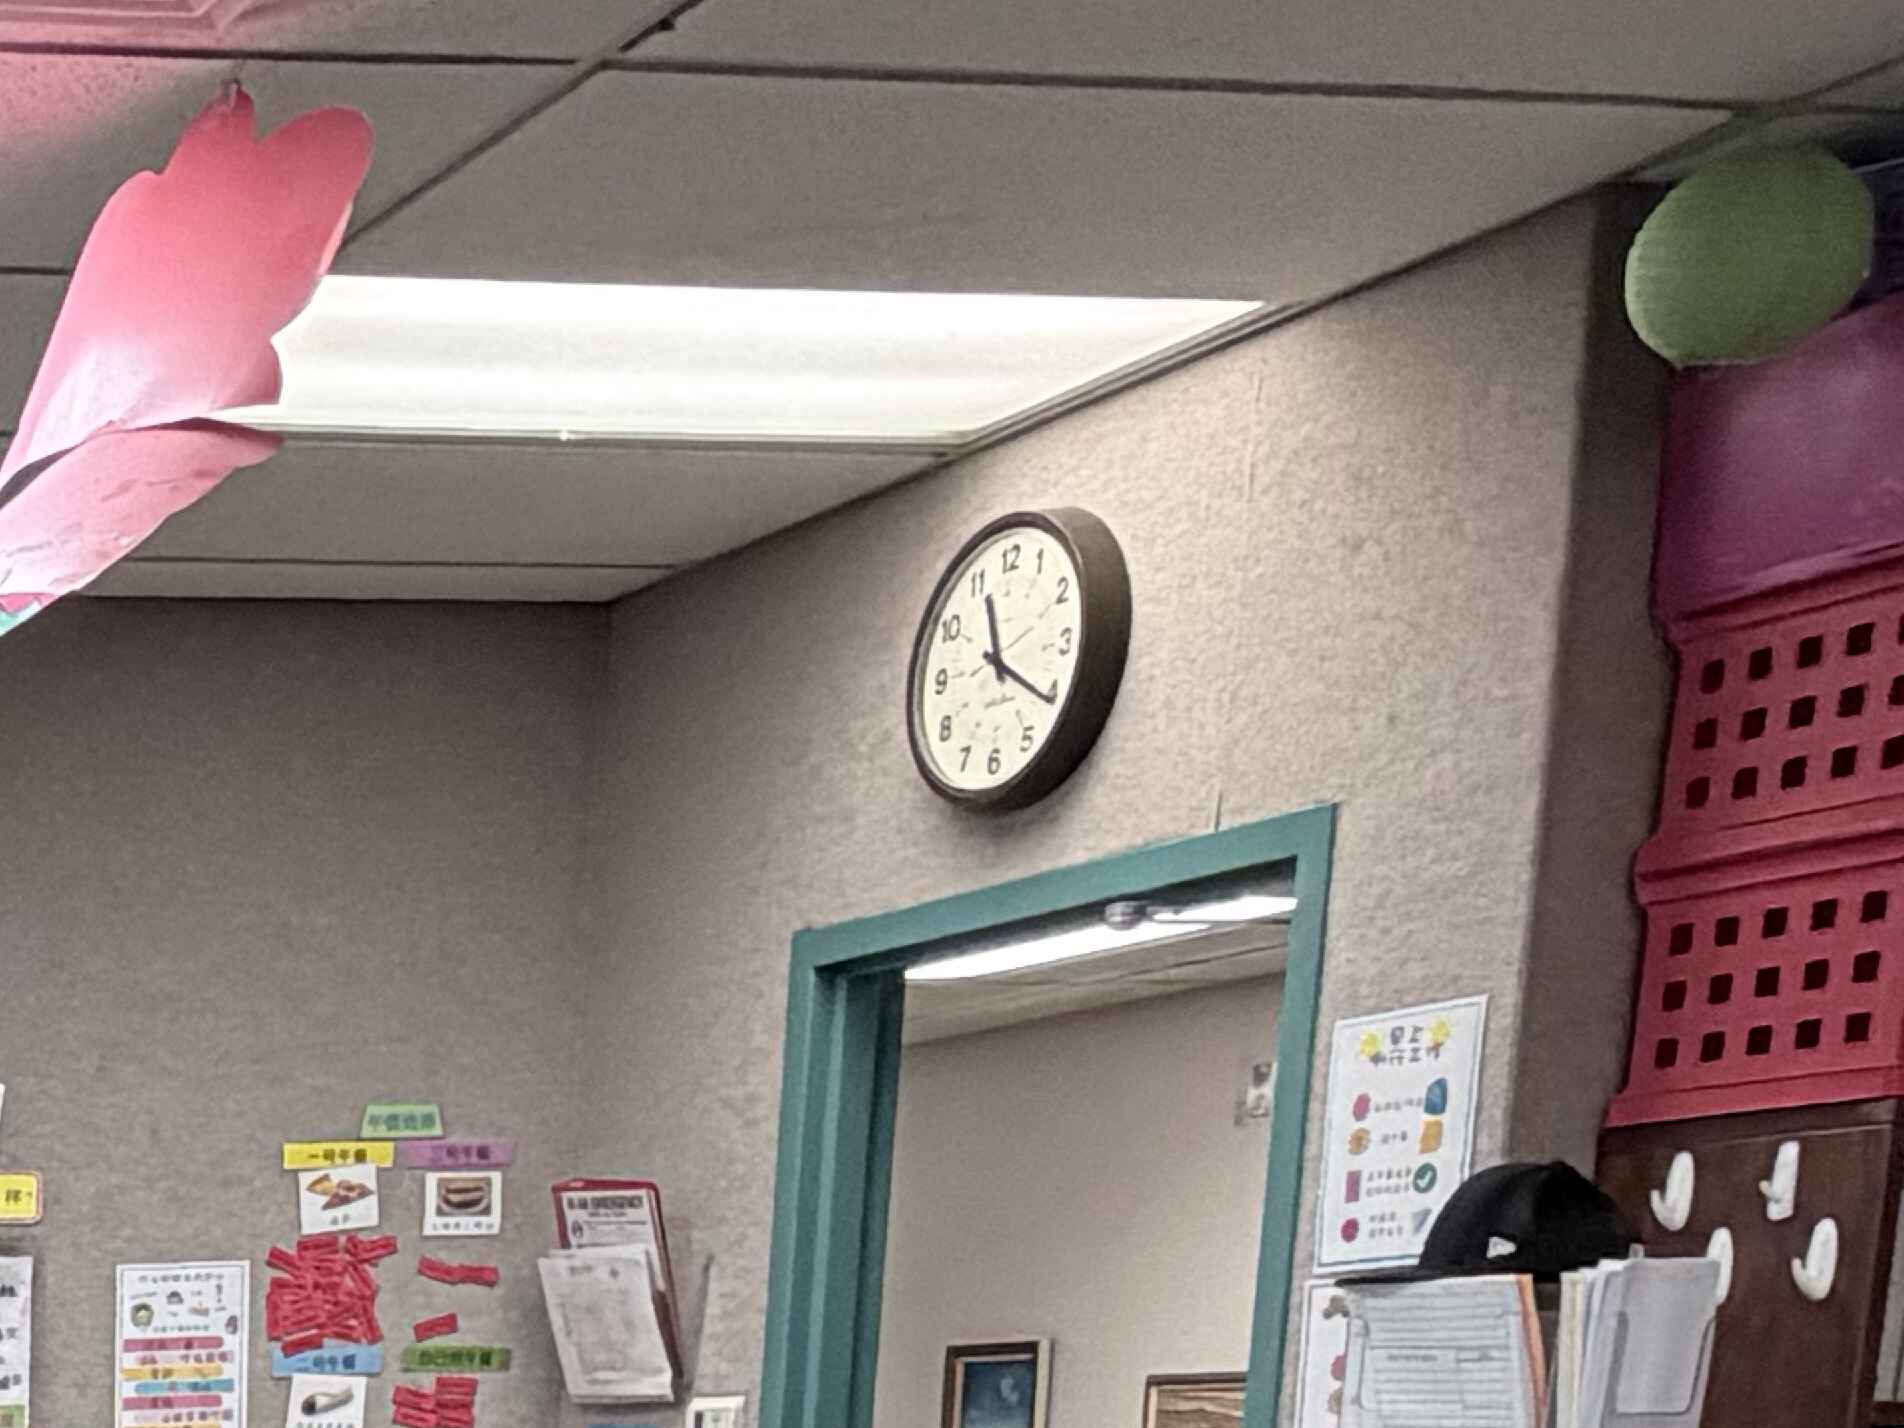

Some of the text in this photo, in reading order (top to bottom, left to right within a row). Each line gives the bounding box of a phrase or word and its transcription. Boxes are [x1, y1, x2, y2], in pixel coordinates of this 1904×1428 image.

[1001, 544, 1021, 575] 12
[1035, 547, 1044, 575] 1
[970, 568, 986, 598] 11
[1055, 576, 1069, 606] 2
[941, 614, 962, 645] 10
[1058, 627, 1073, 657] 3
[934, 668, 949, 696] 9
[938, 714, 953, 743] 8
[1019, 725, 1035, 754] 5
[958, 746, 972, 774] 7
[987, 748, 1001, 776] 6
